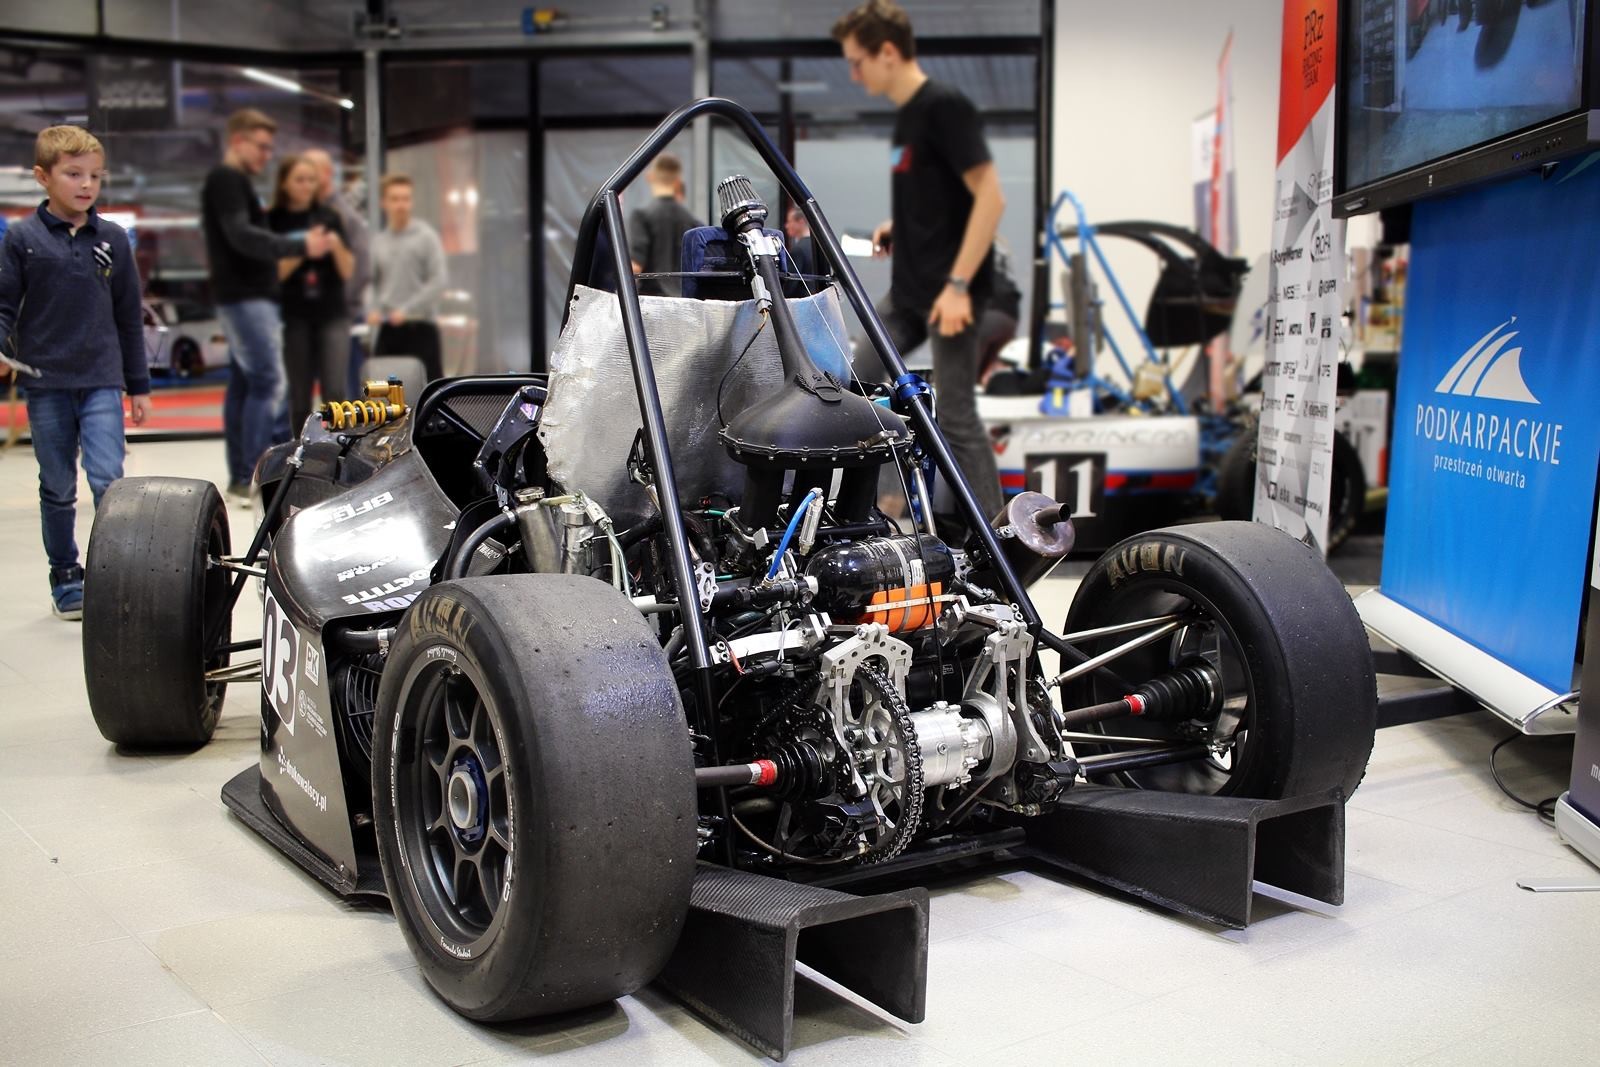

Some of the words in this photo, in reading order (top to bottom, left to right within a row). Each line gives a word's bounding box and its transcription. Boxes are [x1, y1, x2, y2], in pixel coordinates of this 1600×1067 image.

[1415, 404, 1563, 465] PODKARPACKIE
[1032, 458, 1097, 518] 11
[1433, 453, 1483, 479] przestrzeń
[1486, 465, 1527, 489] otwarta
[263, 596, 297, 725] 03
